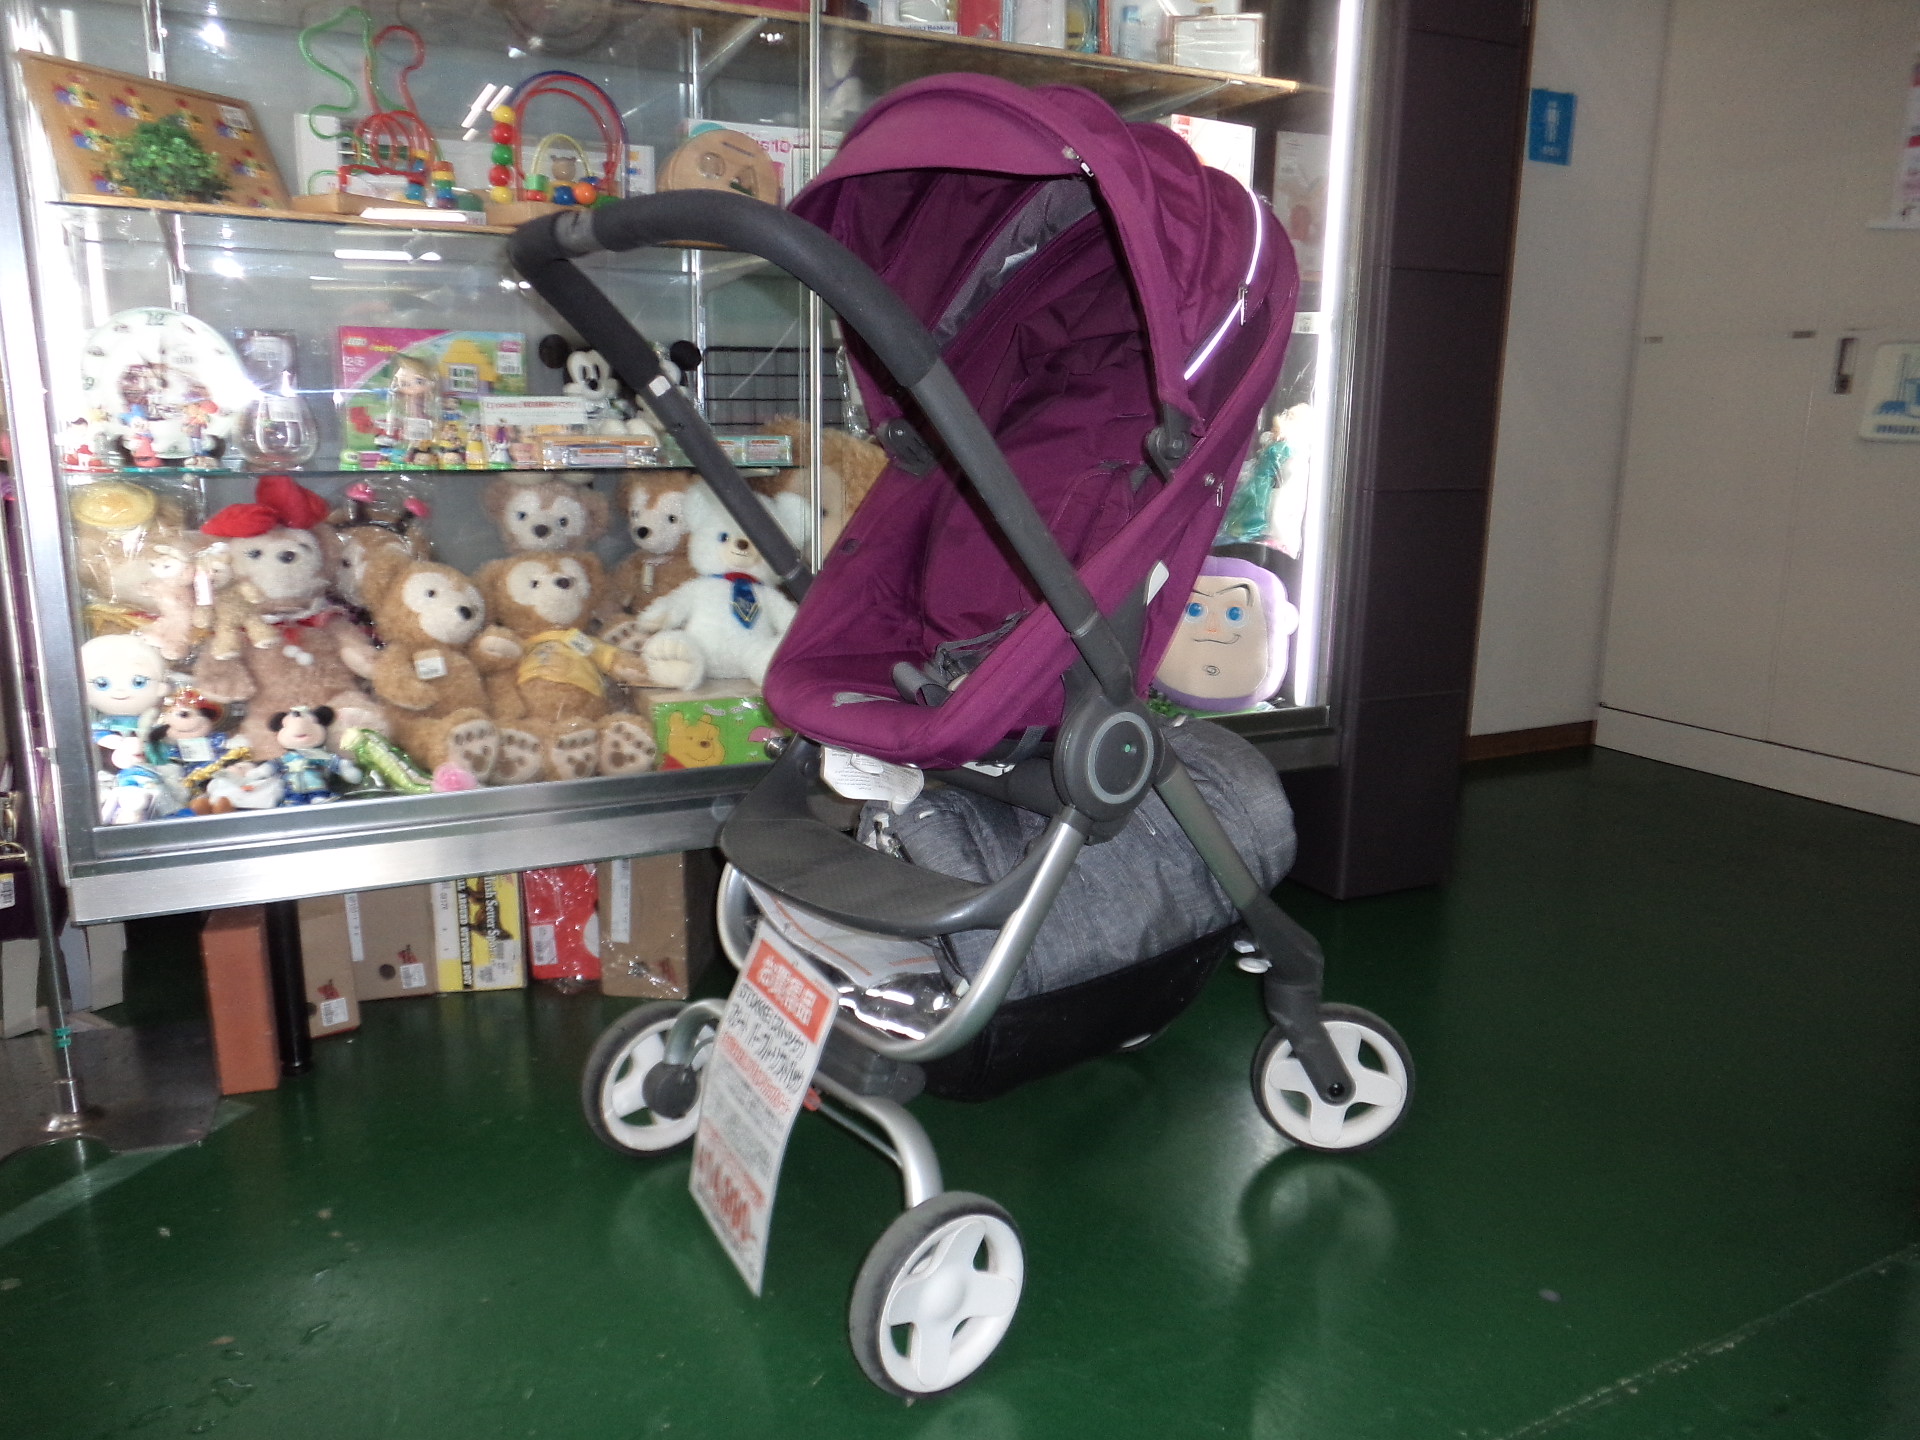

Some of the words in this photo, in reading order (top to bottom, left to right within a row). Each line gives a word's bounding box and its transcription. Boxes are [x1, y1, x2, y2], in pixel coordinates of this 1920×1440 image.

[485, 875, 497, 898] Irish
[459, 892, 468, 925] AROUND
[485, 898, 498, 929] Setter
[461, 926, 471, 962] OUTDOOR
[463, 964, 472, 985] BOOT
